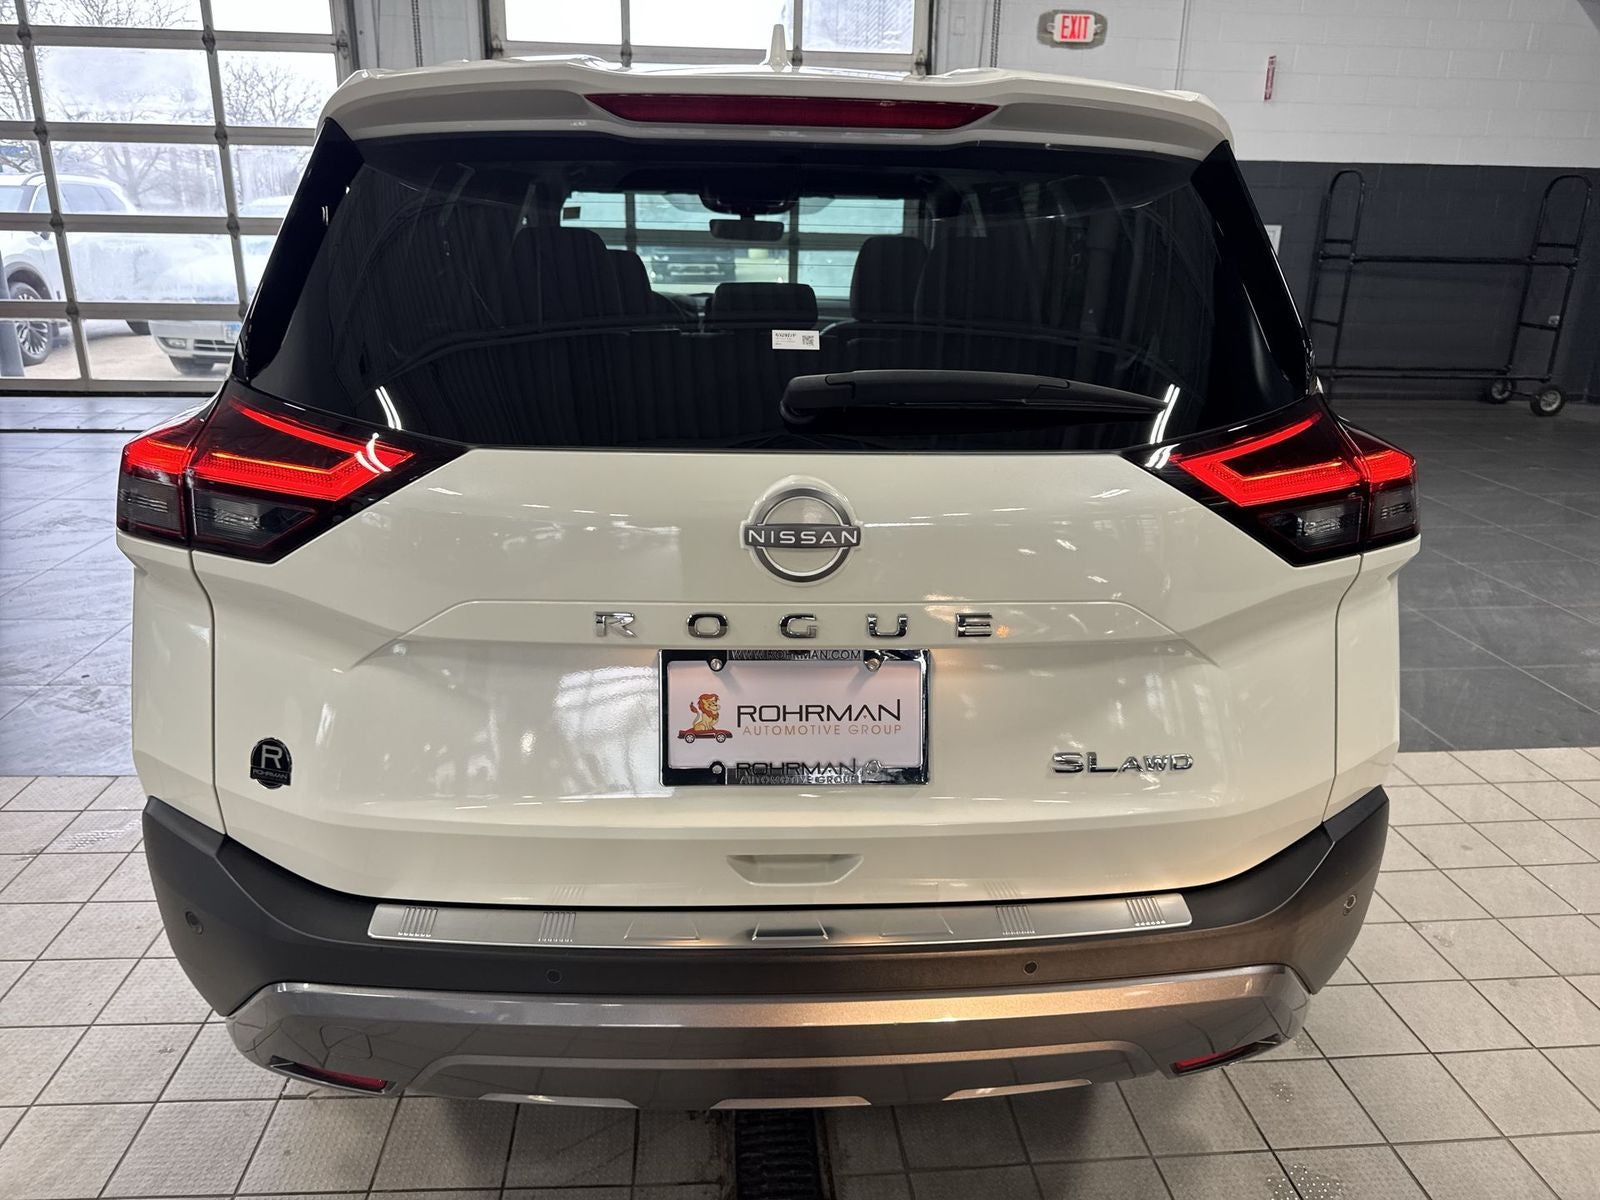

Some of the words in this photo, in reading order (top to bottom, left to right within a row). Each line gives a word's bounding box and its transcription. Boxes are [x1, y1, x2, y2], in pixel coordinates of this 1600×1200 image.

[1060, 15, 1091, 40] EXIT
[748, 530, 858, 544] NISSAN
[595, 611, 994, 639] ROGUE
[731, 649, 862, 660] WWW.ROHRMAN.COM
[736, 698, 901, 728] ROHRMAN
[742, 724, 841, 736] AUTOMOTIVE
[848, 724, 902, 736] GROUP
[261, 744, 283, 769] R
[1052, 751, 1118, 774] SL
[1118, 753, 1194, 773] AWD
[736, 758, 856, 778] ROHRMAN
[739, 775, 812, 785] AUTOMOTIVE
[814, 775, 859, 785] GROUP
